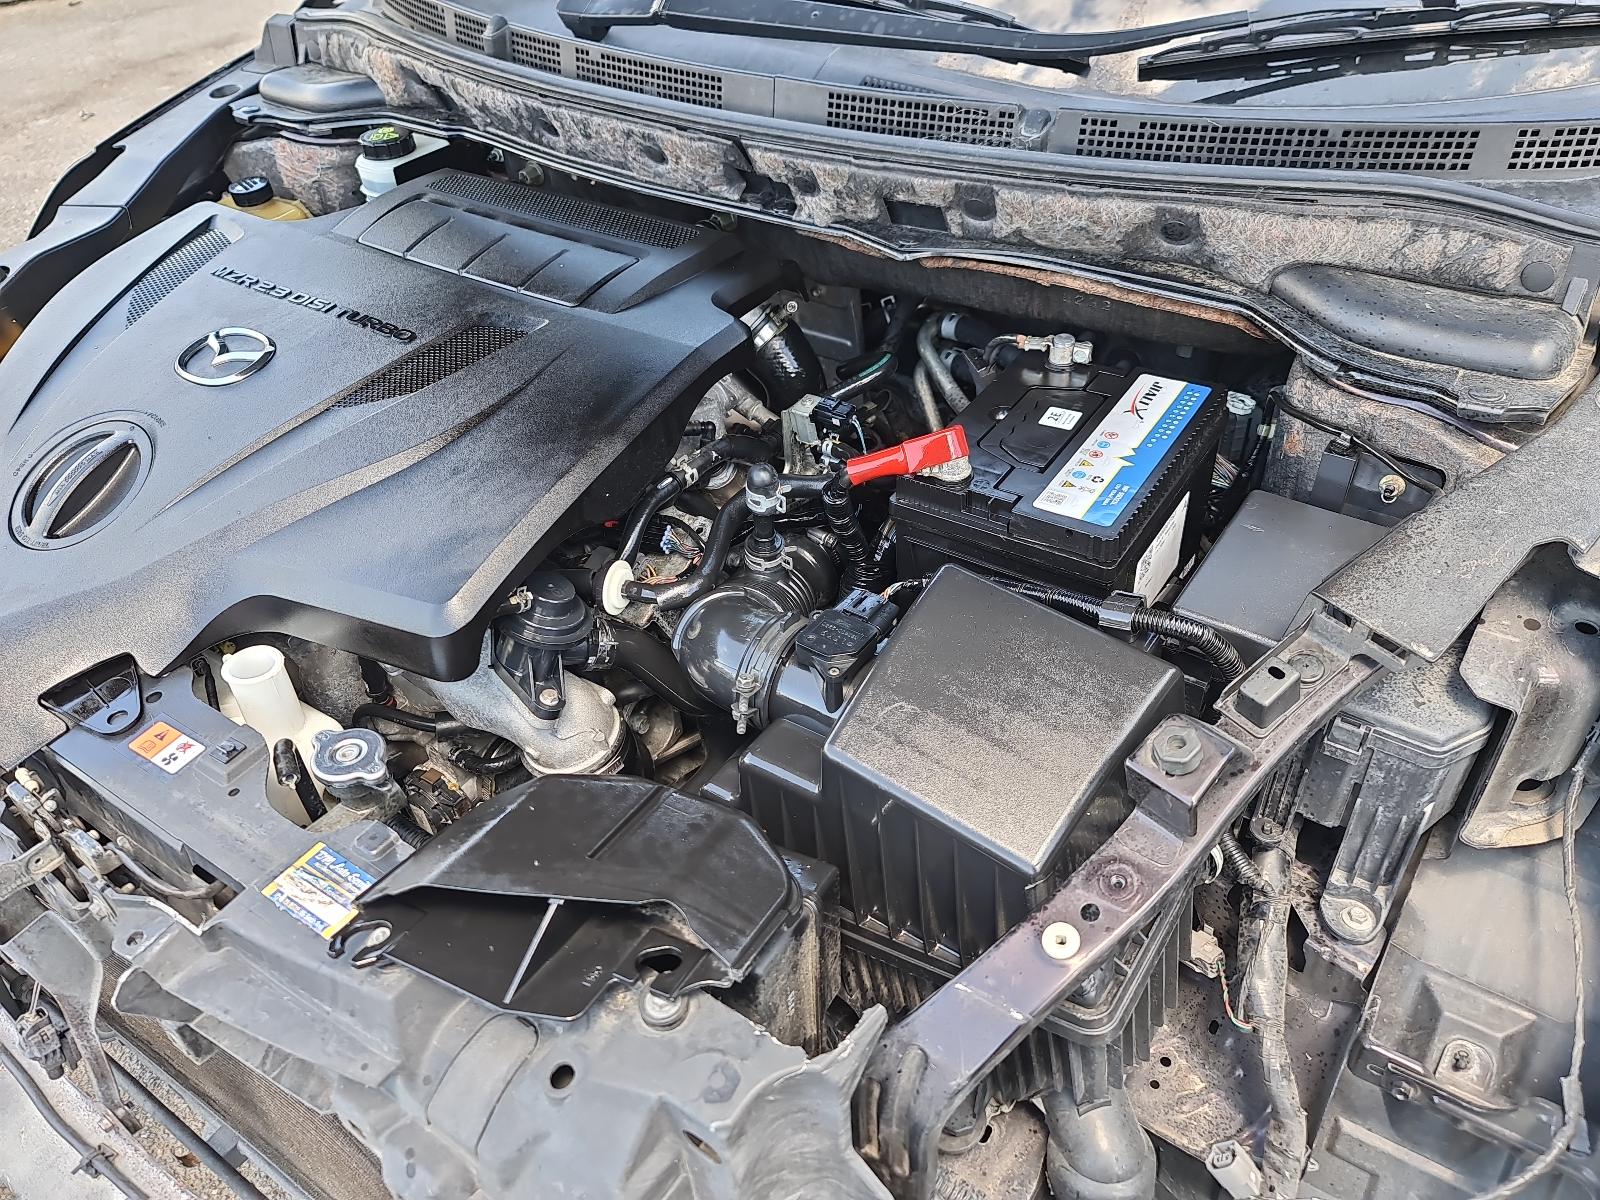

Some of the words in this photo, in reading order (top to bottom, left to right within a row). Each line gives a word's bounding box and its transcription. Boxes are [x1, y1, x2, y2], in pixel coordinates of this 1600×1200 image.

[210, 266, 260, 288] MZR
[288, 292, 337, 314] DISI
[336, 307, 418, 344] TURBO
